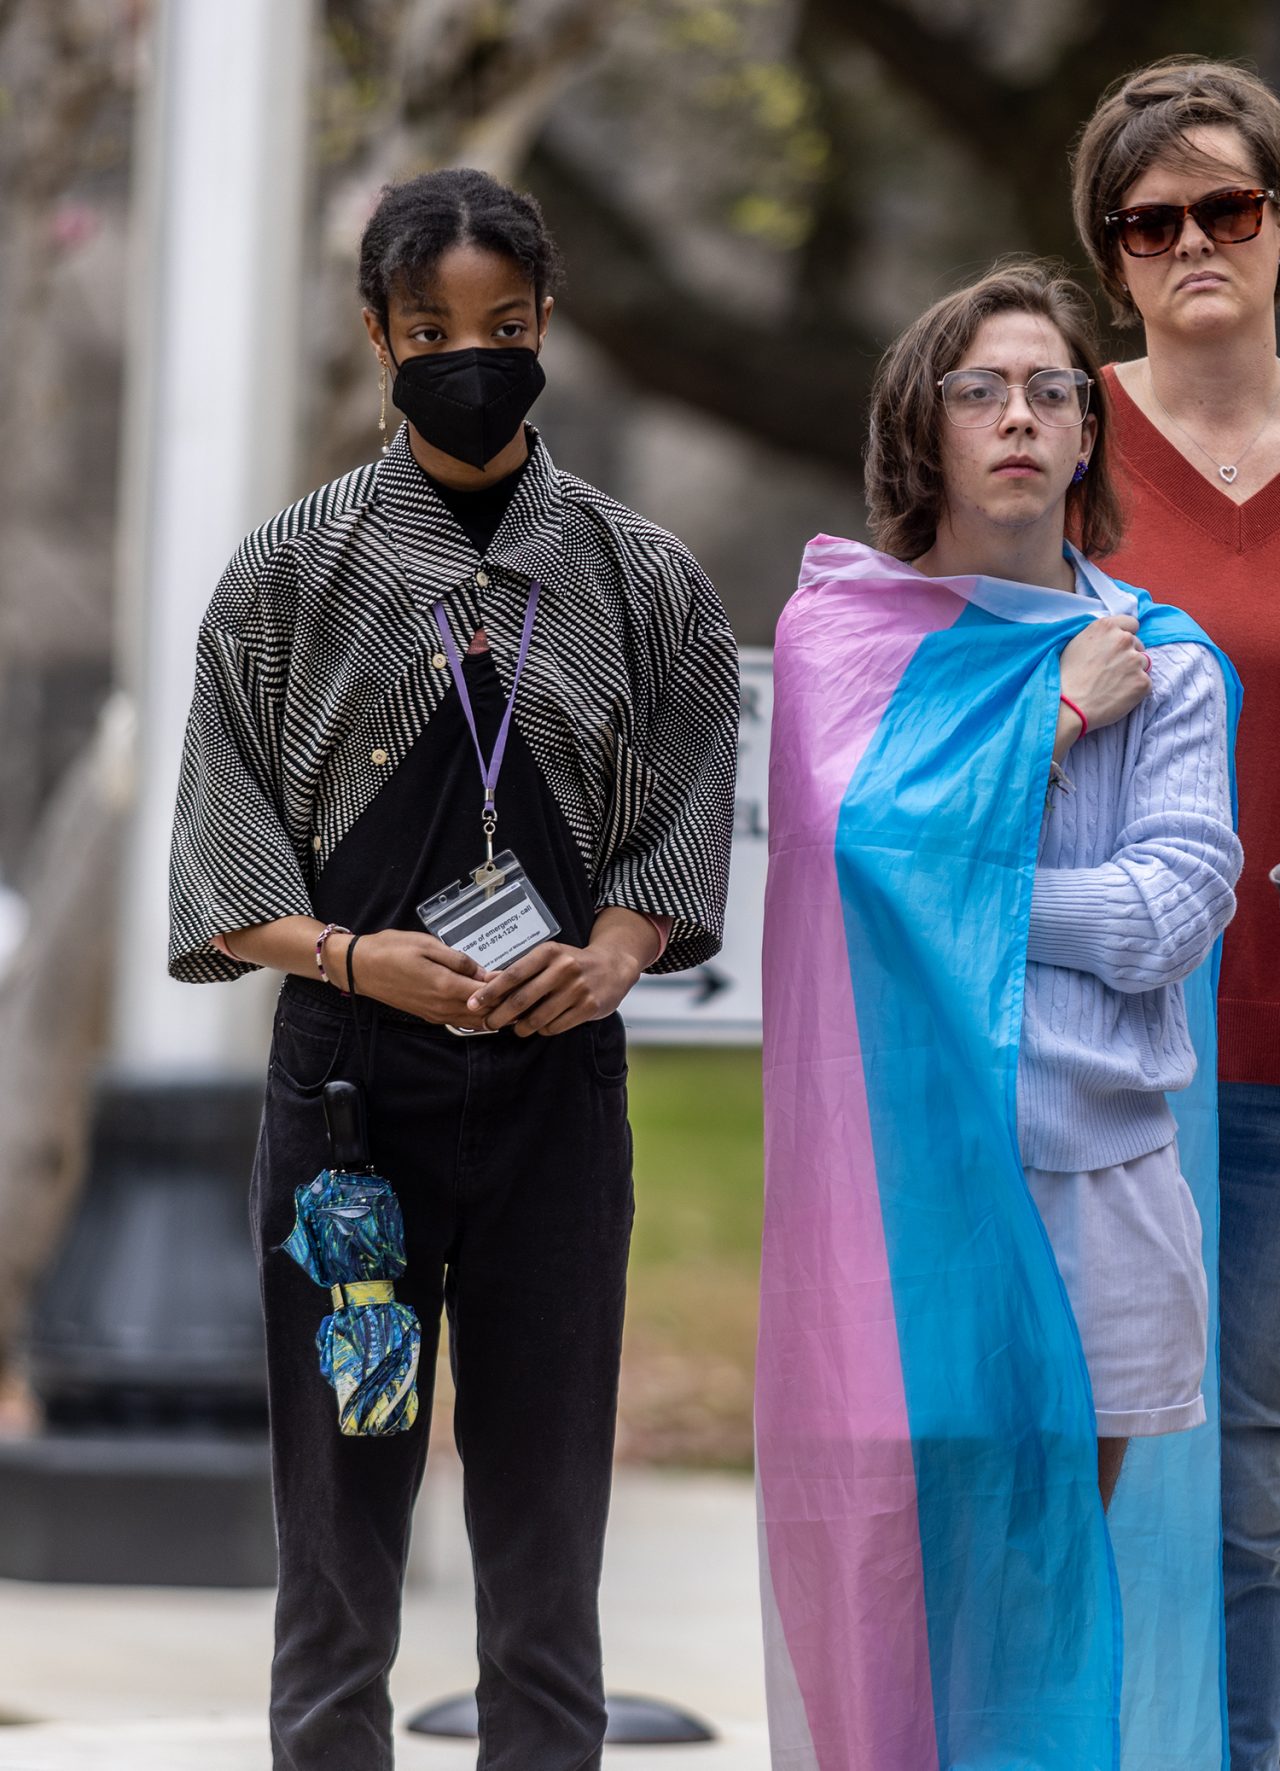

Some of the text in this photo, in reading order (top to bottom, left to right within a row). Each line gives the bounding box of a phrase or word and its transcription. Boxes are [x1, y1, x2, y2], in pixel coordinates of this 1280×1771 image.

[462, 940, 477, 952] case
[477, 934, 485, 942] of
[520, 905, 532, 915] call
